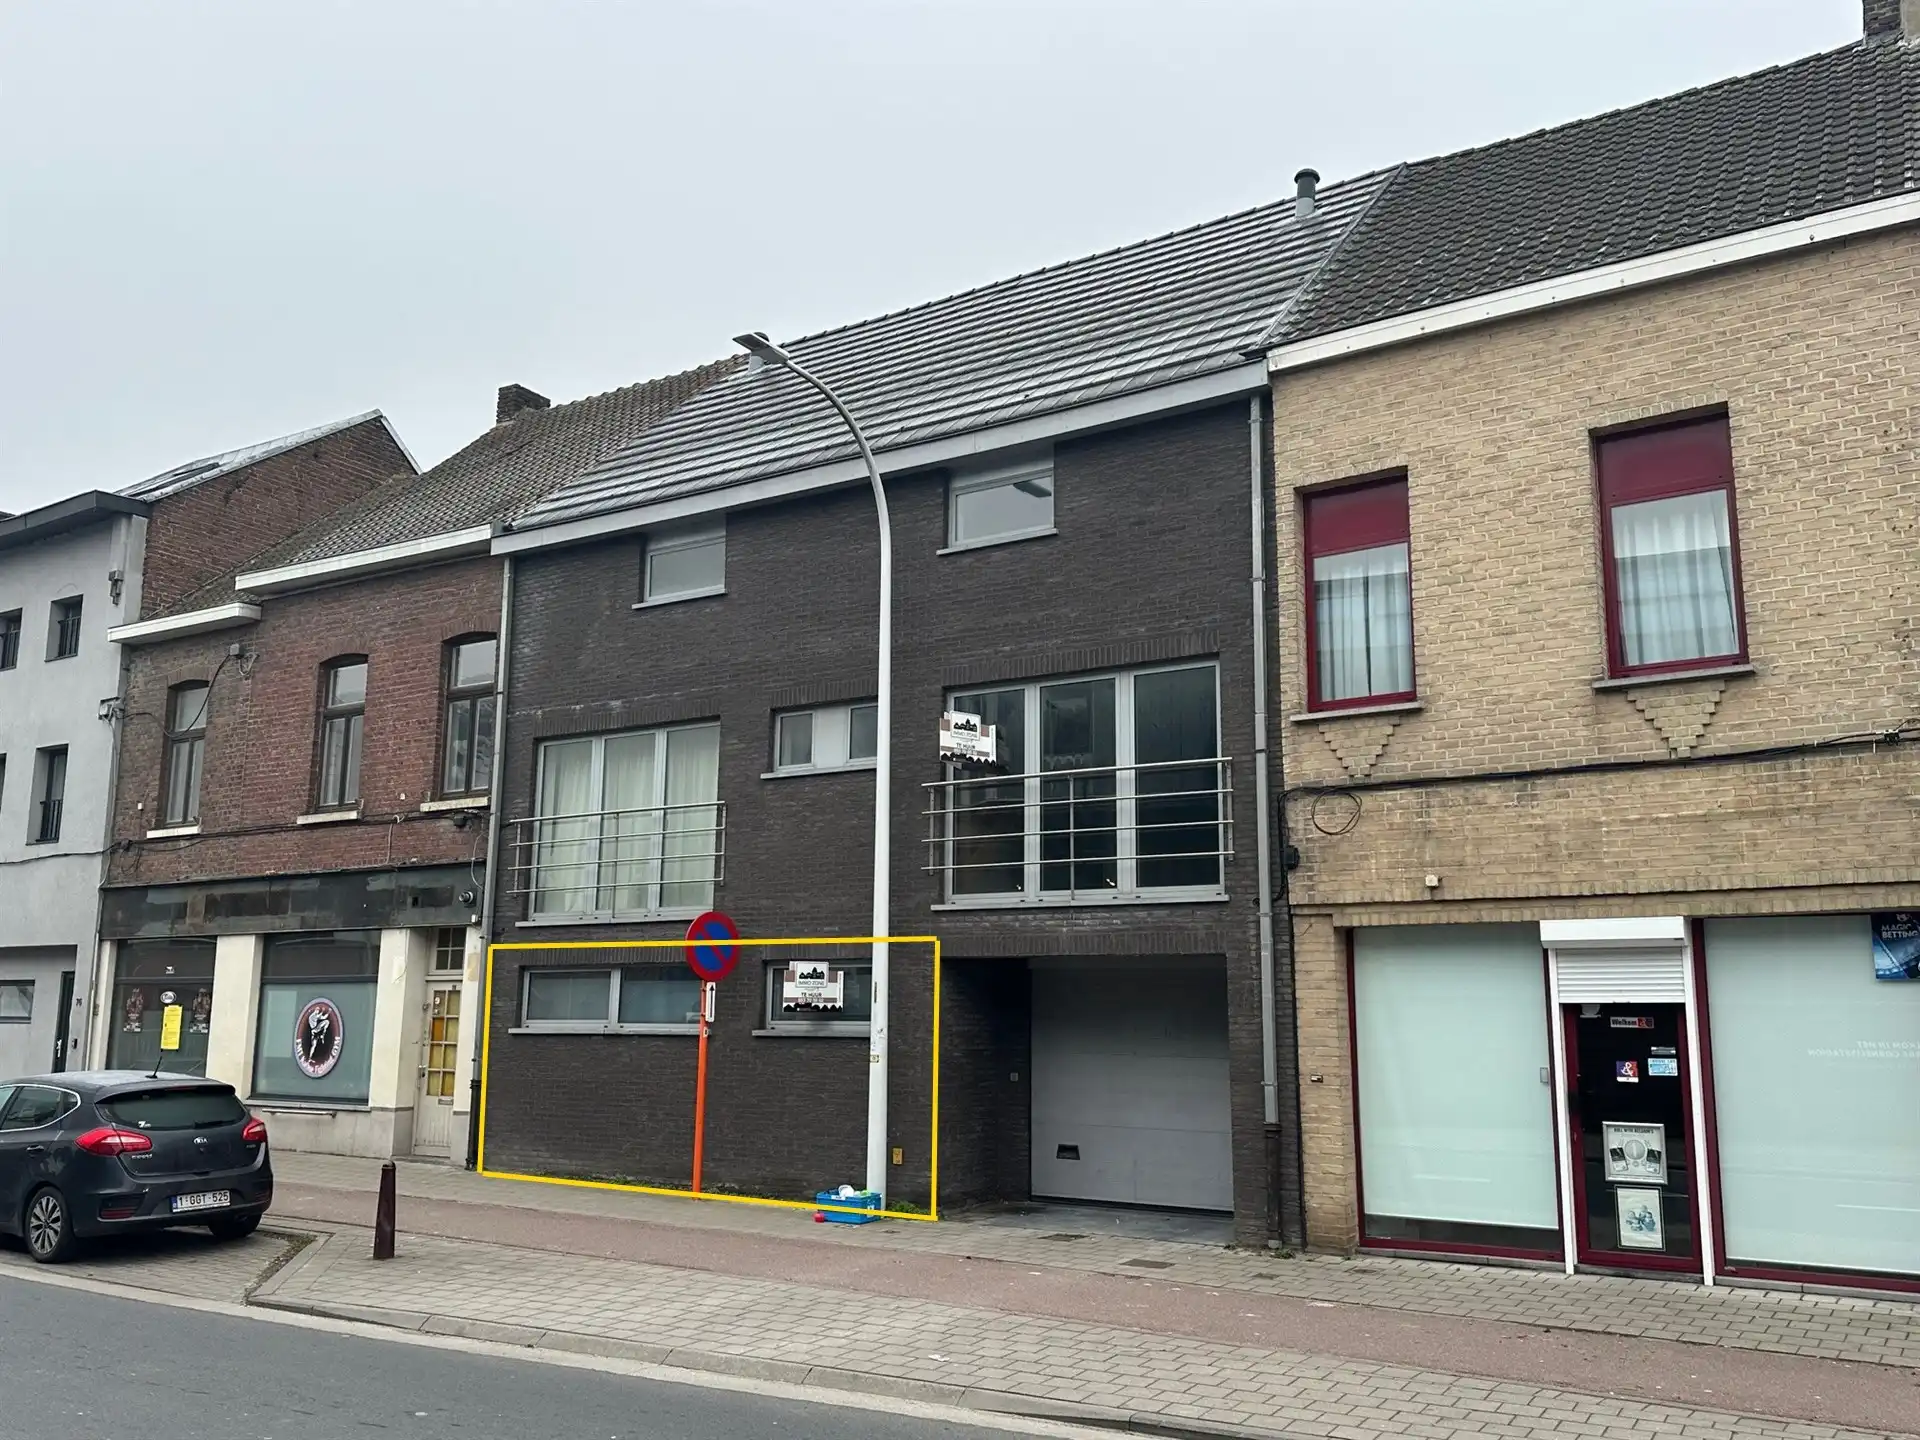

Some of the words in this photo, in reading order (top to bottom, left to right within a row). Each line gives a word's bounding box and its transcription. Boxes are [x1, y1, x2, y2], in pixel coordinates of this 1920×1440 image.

[1881, 923, 1912, 931] MAGIC
[1882, 930, 1919, 939] BETTING
[1611, 1018, 1638, 1026] Welkom
[178, 1191, 229, 1206] 1-GGT-525
